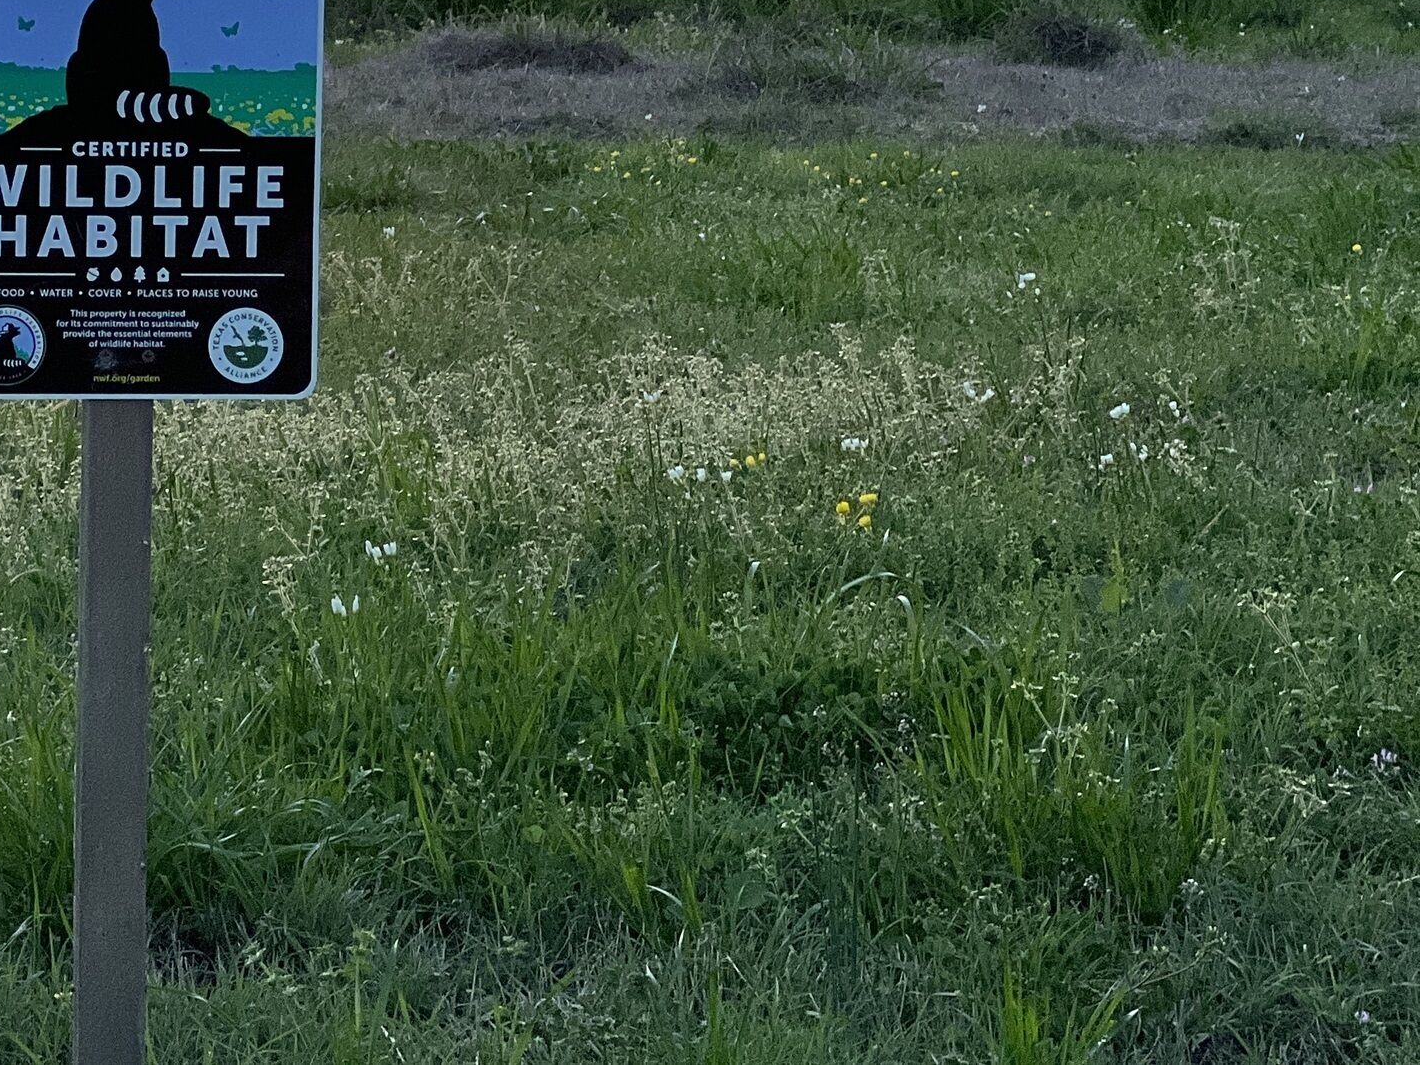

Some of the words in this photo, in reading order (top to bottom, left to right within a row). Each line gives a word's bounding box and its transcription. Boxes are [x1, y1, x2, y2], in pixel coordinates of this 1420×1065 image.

[72, 142, 188, 157] CERTIFIED
[40, 289, 73, 297] WATER
[88, 289, 122, 297] COVER
[137, 289, 173, 298] PLACES
[175, 289, 190, 298] TO
[192, 289, 220, 298] RAISE
[222, 289, 259, 298] YOUNG
[70, 309, 88, 317] This
[90, 310, 127, 319] property
[129, 309, 136, 317] is
[137, 309, 186, 319] recognized
[56, 319, 69, 327] for
[151, 319, 199, 329] sustainably
[62, 330, 96, 339] provide
[212, 321, 228, 350] TEXAS
[228, 313, 278, 352] CONSERVATION
[224, 366, 267, 379] ALLIANCE
[93, 374, 161, 384] nwf.org/garden
